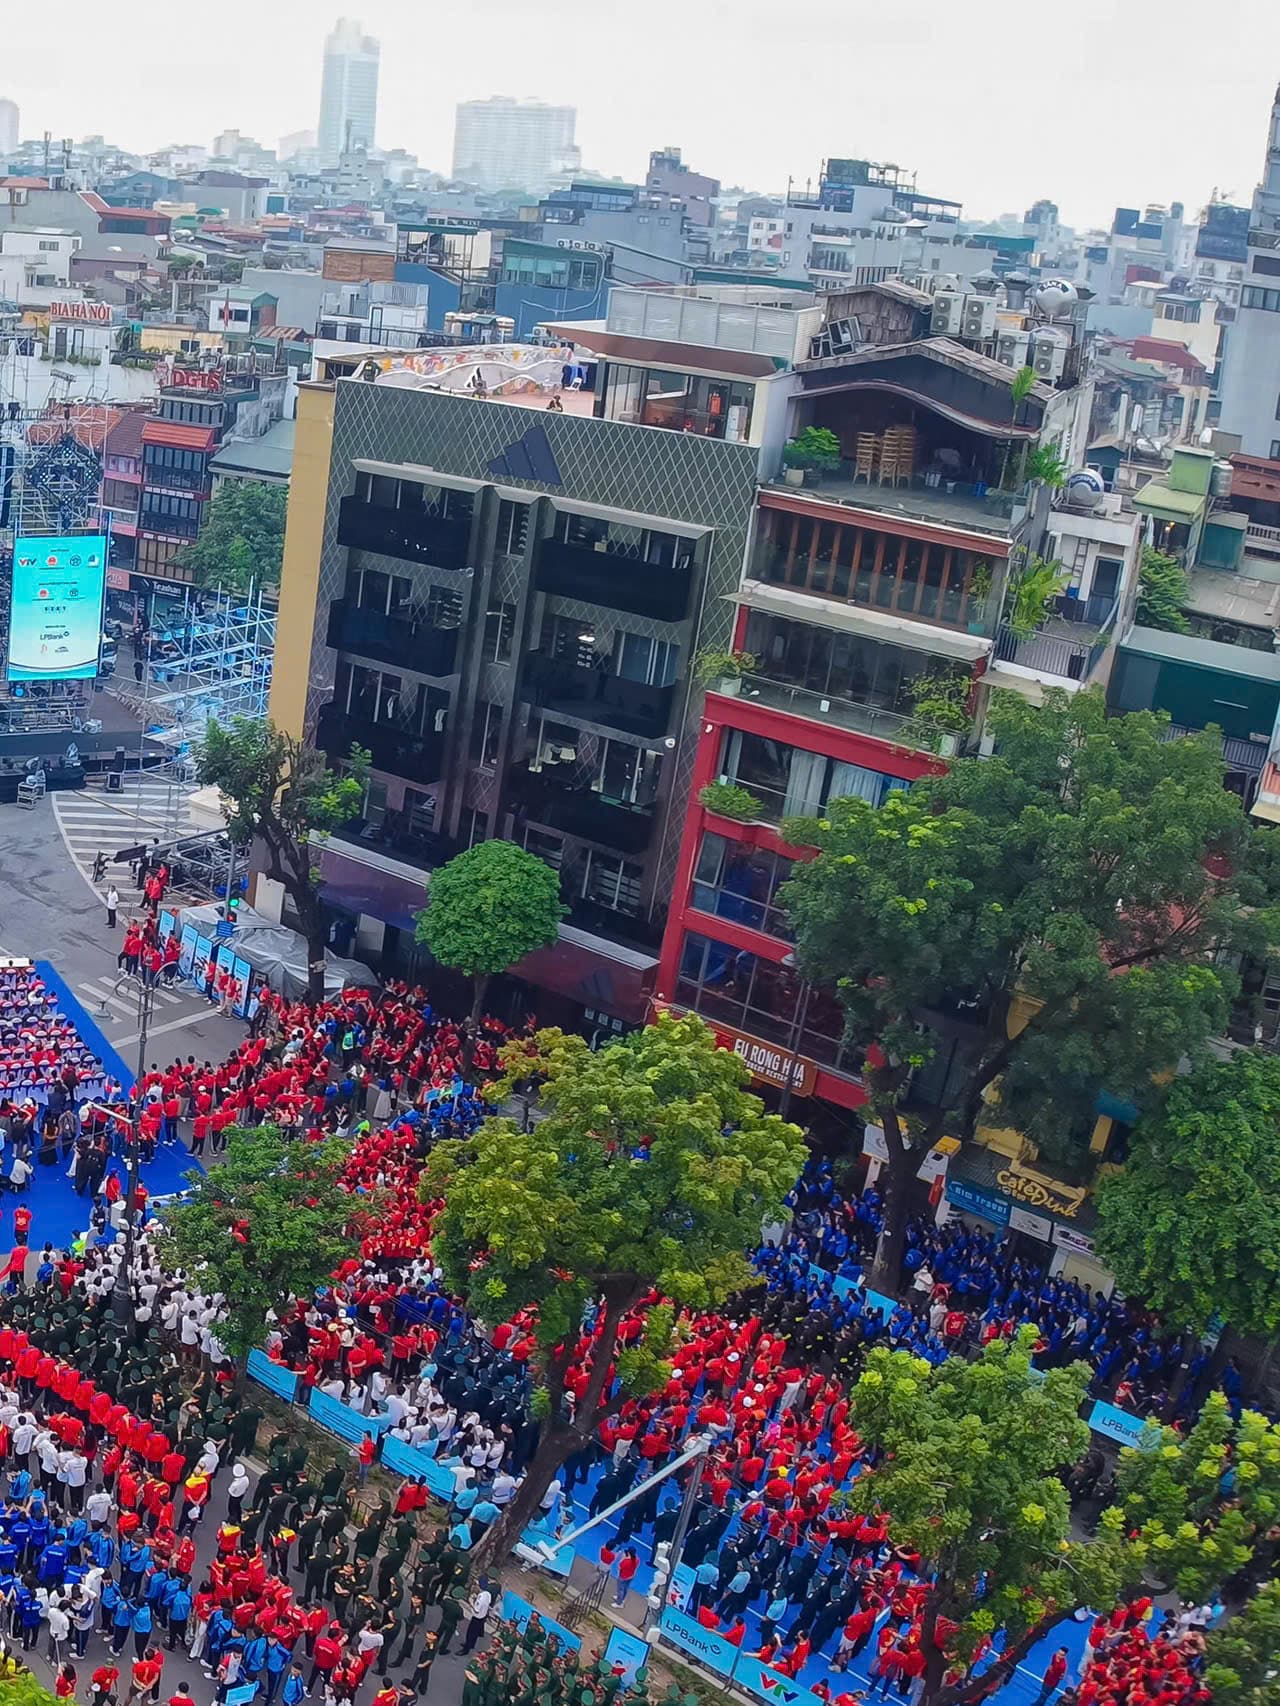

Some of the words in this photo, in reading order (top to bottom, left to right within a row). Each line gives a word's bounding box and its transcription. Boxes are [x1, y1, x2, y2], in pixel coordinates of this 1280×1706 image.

[51, 303, 70, 316] BIA
[749, 1045, 781, 1071] RONG
[665, 1619, 709, 1654] LPBank
